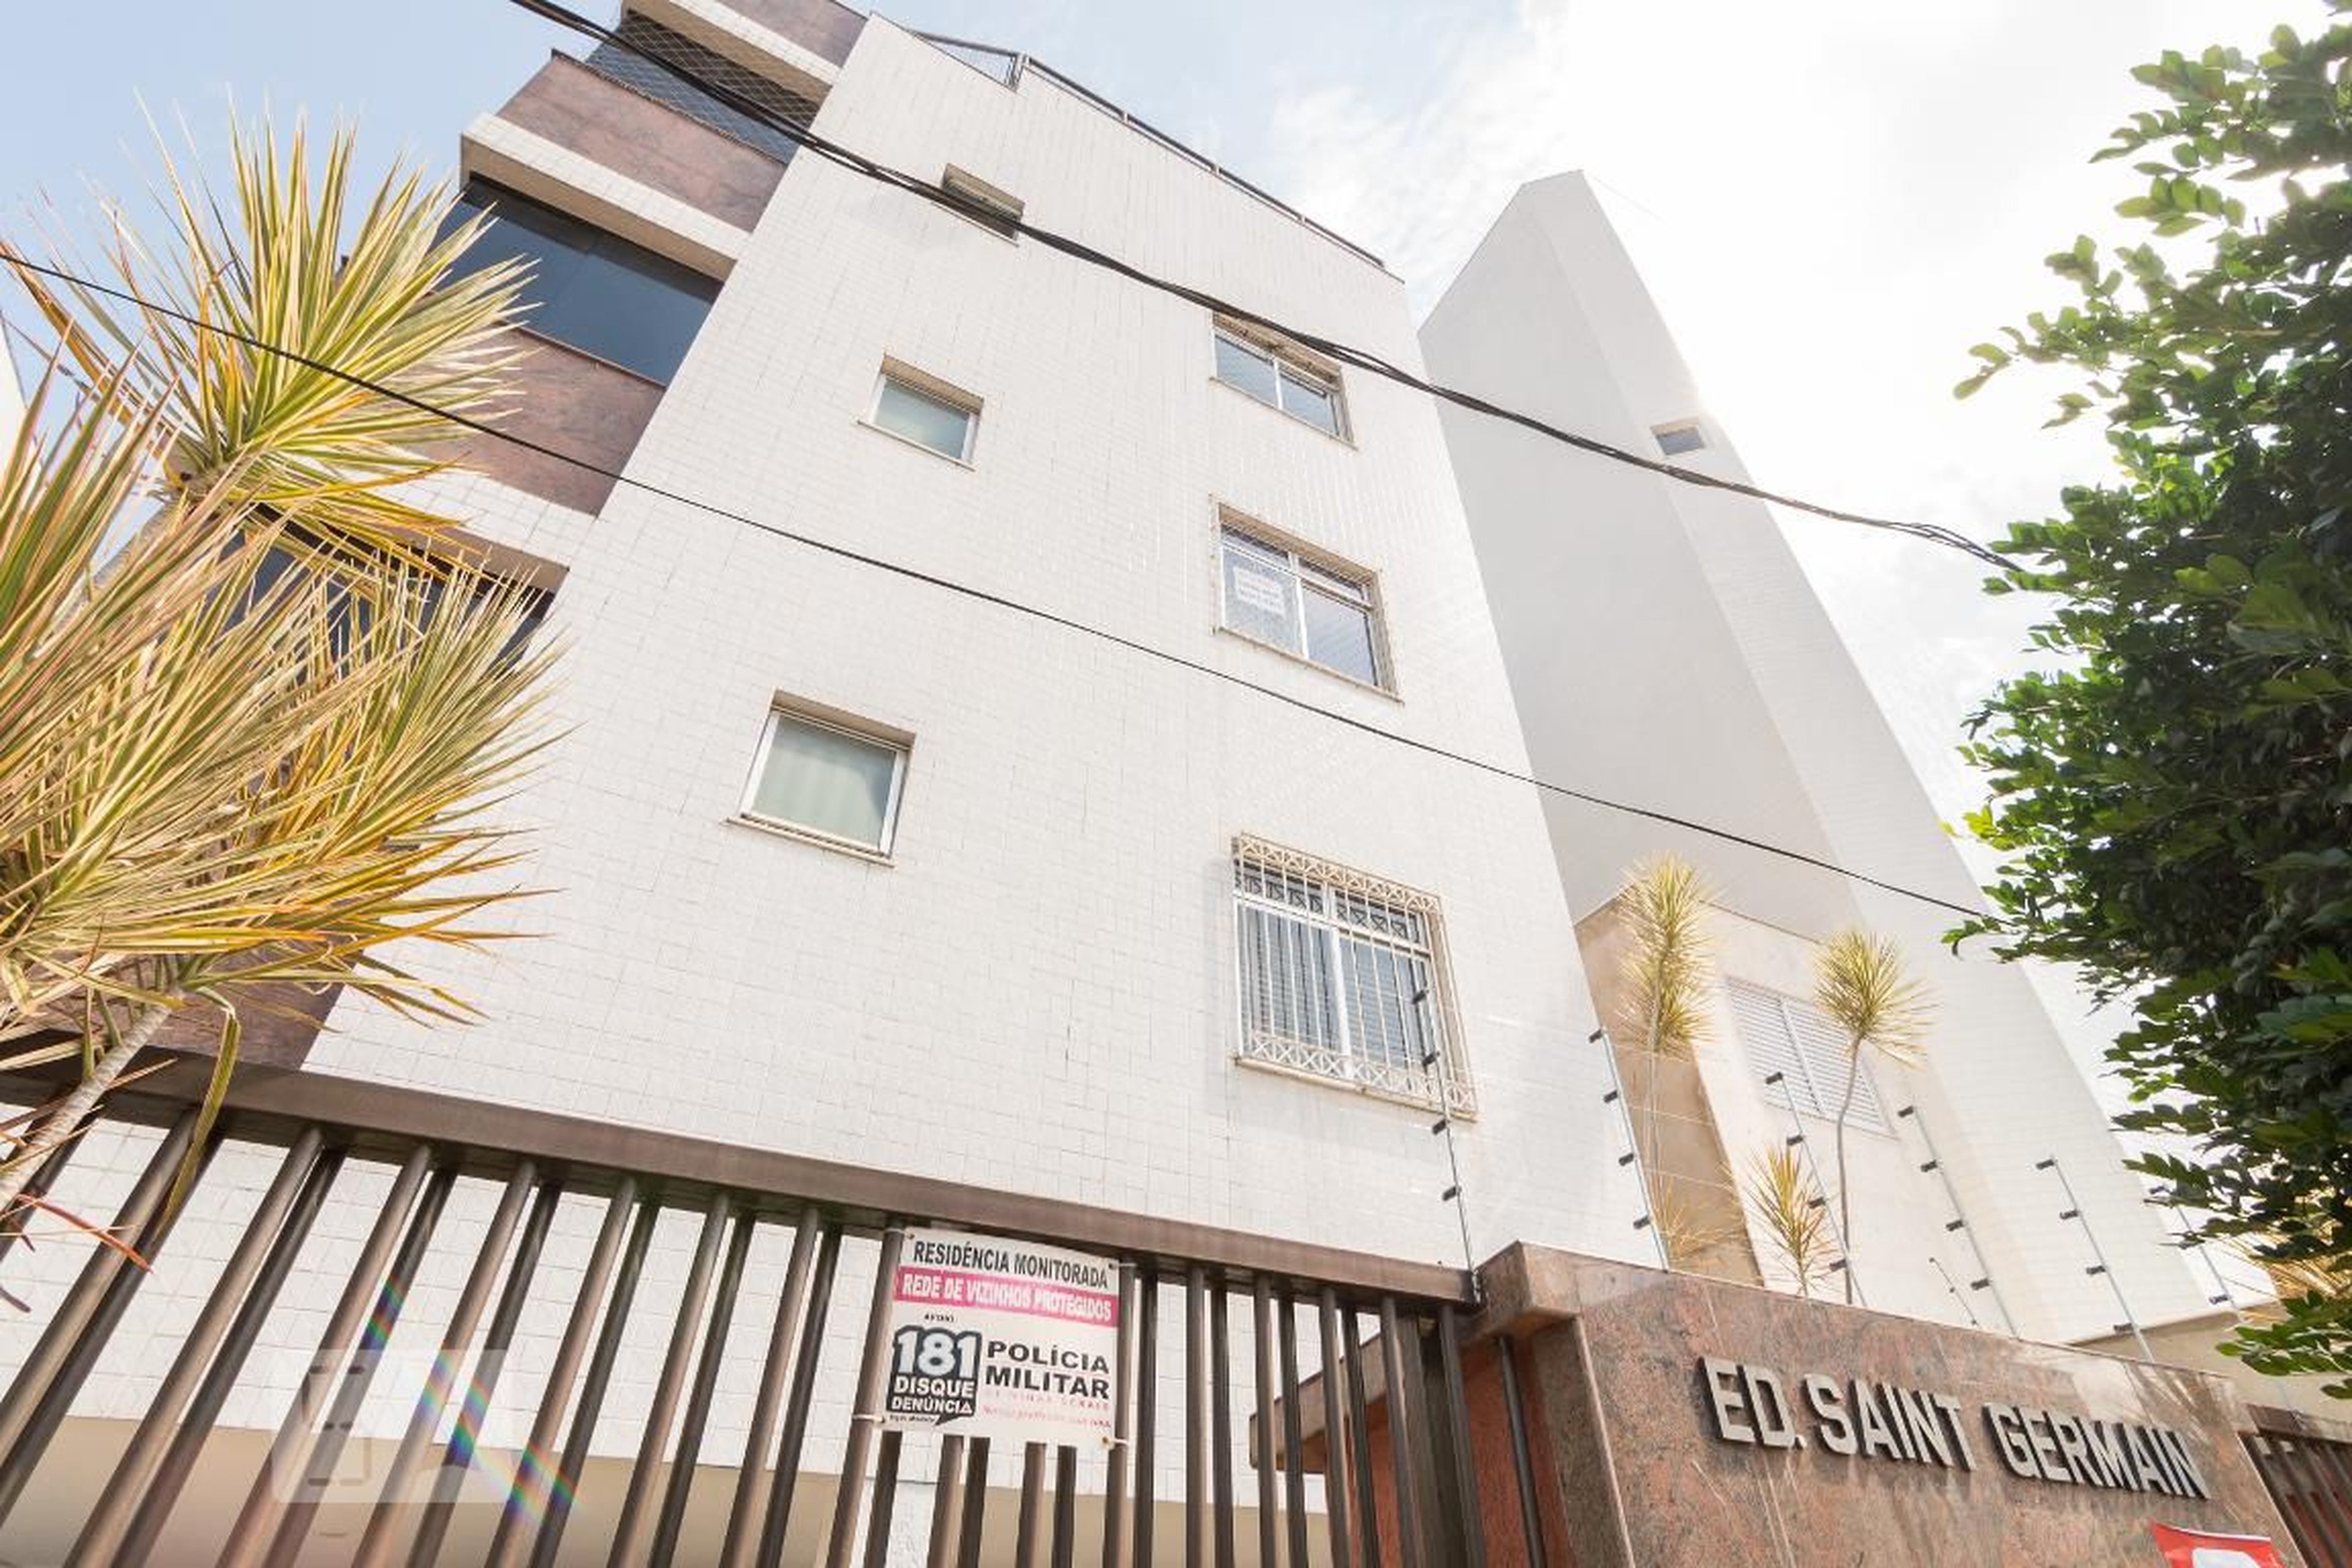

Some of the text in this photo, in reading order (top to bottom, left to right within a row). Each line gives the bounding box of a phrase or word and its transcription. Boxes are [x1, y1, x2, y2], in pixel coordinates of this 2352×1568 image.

[1014, 1253, 1108, 1289] MONITORADA
[902, 1273, 1112, 1322] REDE DE VIZINHOS PROTEGIDOS
[897, 1330, 975, 1378] 181
[987, 1341, 1109, 1373] POLÍCIA
[893, 1376, 975, 1399] DISQUE
[985, 1365, 1109, 1400] MILITAR
[891, 1396, 973, 1414] DENÚNCIA
[1803, 1373, 1977, 1471] SAINT
[1983, 1403, 2212, 1500] GERMAIN
